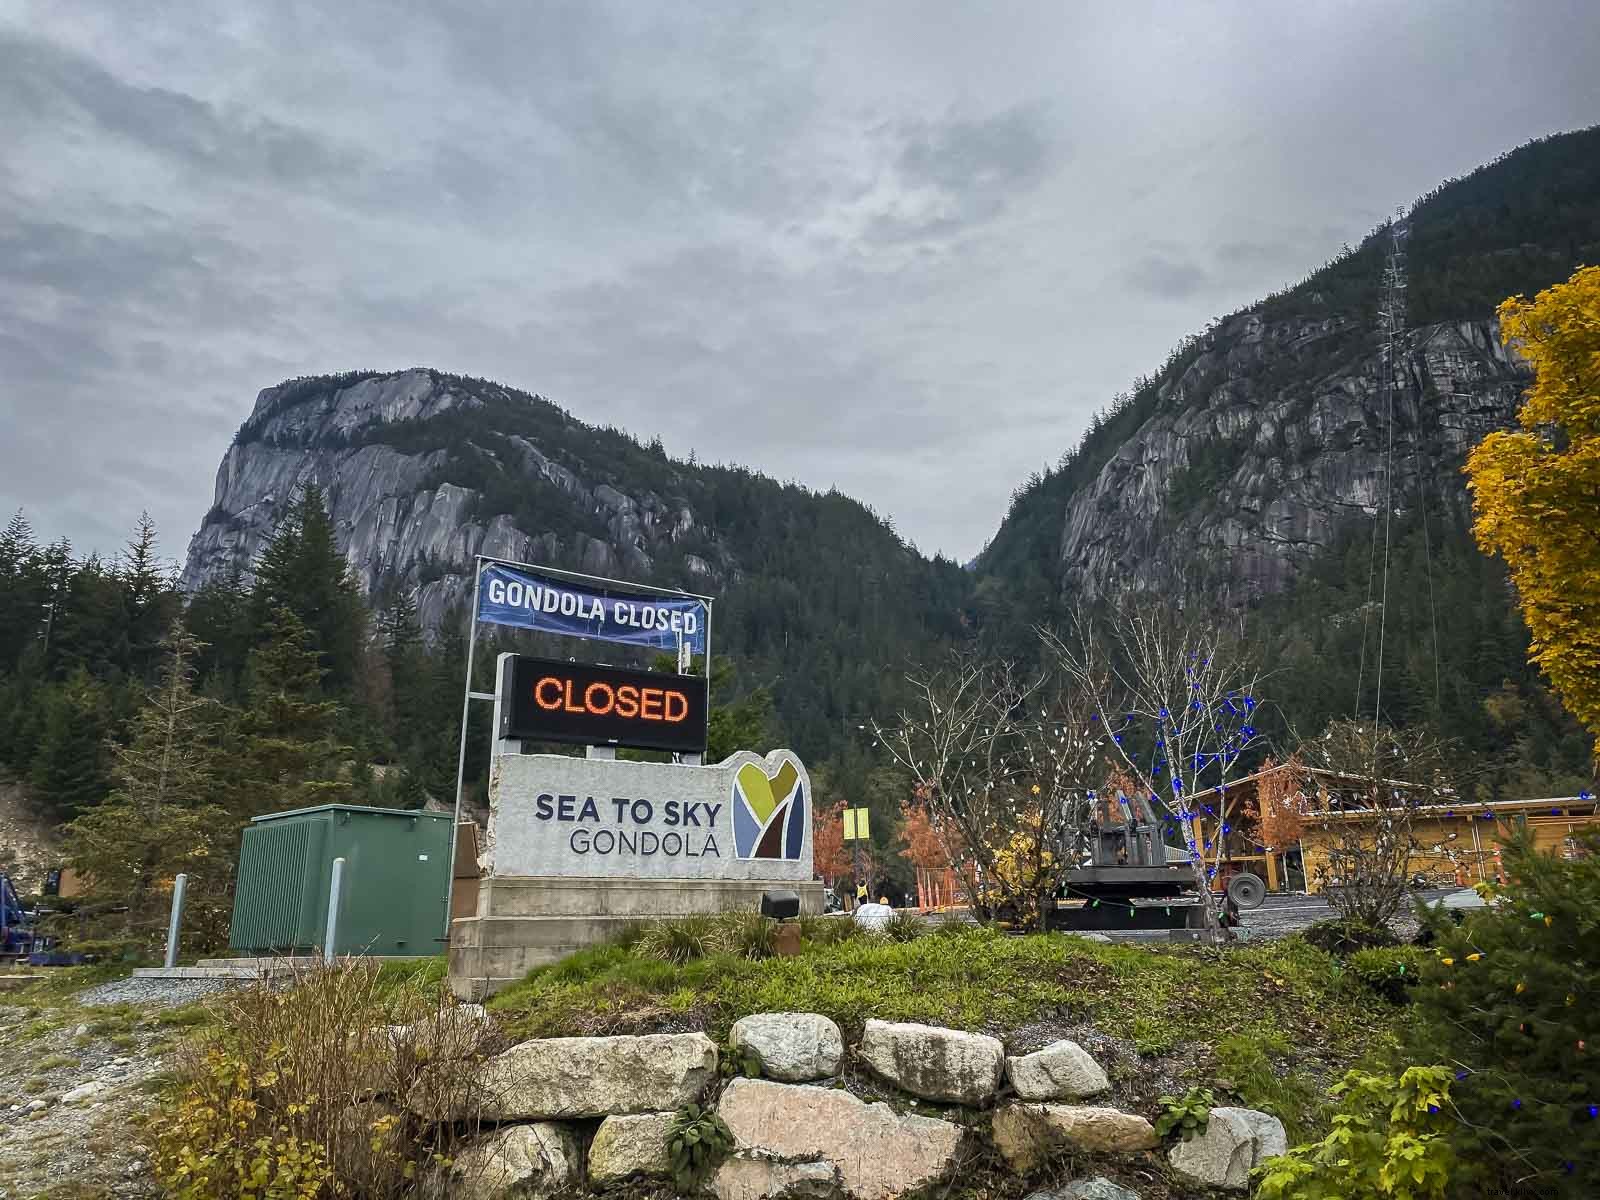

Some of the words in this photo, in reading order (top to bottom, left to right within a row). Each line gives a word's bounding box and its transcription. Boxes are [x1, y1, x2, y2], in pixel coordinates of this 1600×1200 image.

[488, 578, 605, 621] GONDOLA
[613, 602, 697, 634] CLOSED
[535, 677, 688, 722] CLOSED
[535, 793, 600, 822] SEA
[612, 798, 654, 825] TO
[664, 801, 722, 828] SKY
[569, 828, 721, 858] GONDOLA
